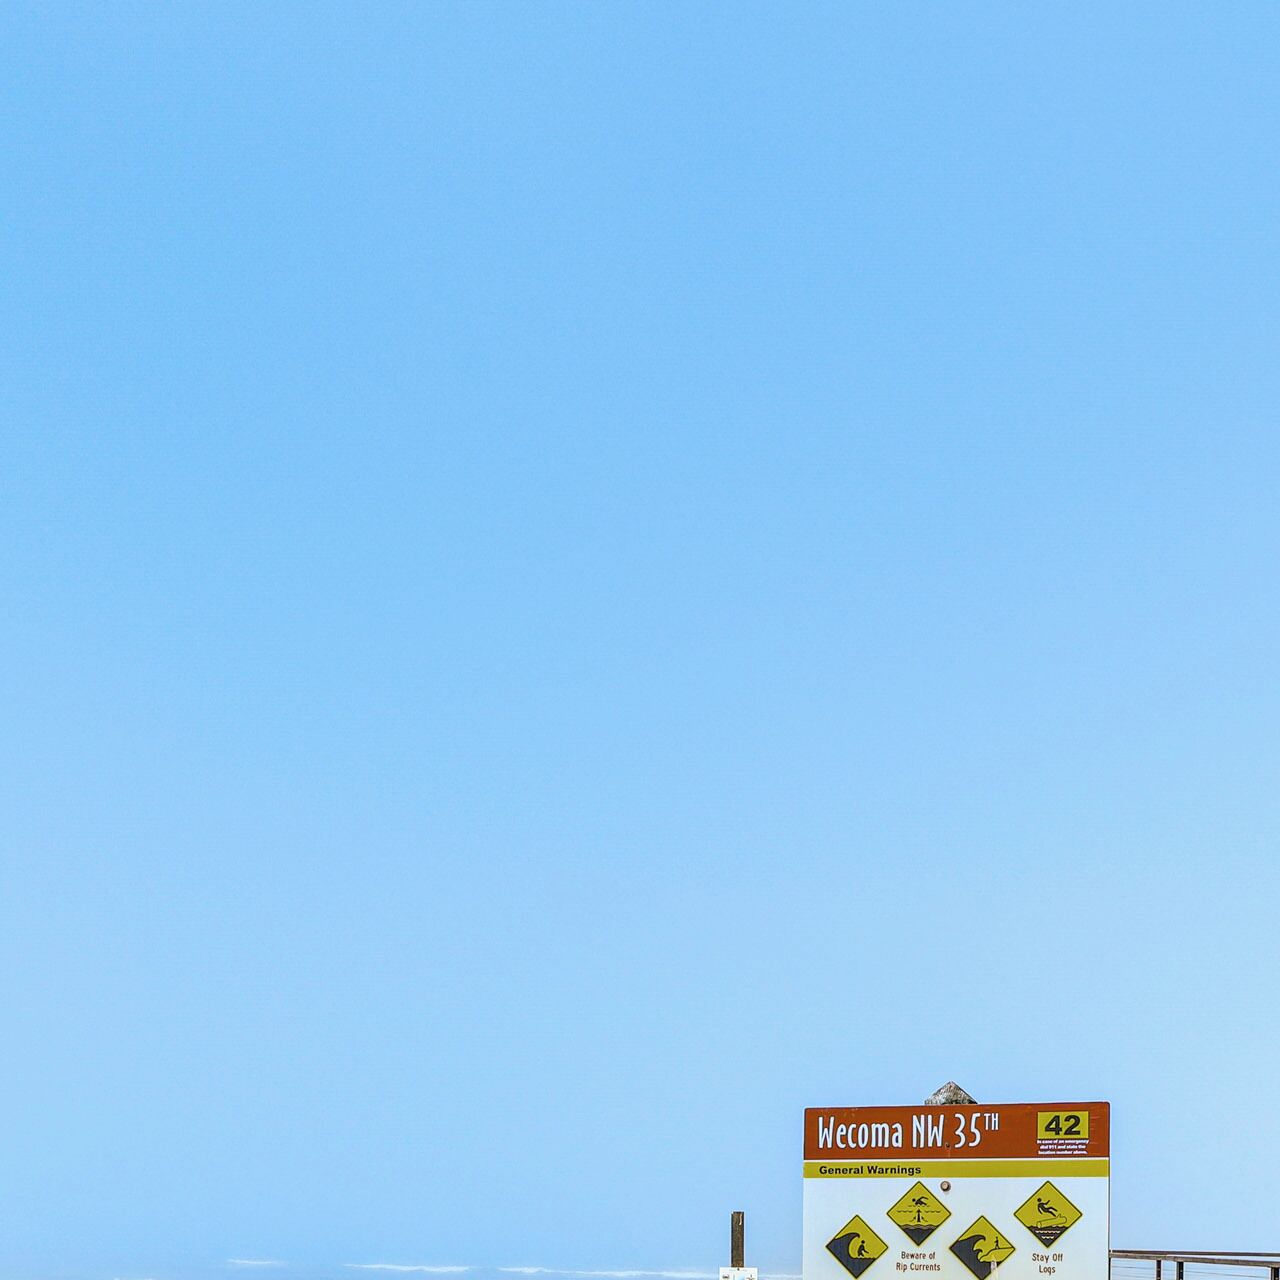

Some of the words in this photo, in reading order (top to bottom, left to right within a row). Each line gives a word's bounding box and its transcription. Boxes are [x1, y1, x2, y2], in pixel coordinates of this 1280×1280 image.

[1044, 1115, 1081, 1136] 42
[818, 1116, 903, 1148] Wecoma
[912, 1114, 945, 1148] NW
[819, 1165, 864, 1175] General
[868, 1165, 921, 1176] Warnings
[901, 1251, 927, 1259] Beware
[1032, 1253, 1049, 1263] Stay
[1052, 1253, 1064, 1262] Off
[896, 1262, 907, 1272] Rip
[910, 1263, 940, 1271] Currents
[1039, 1265, 1056, 1275] Logs
